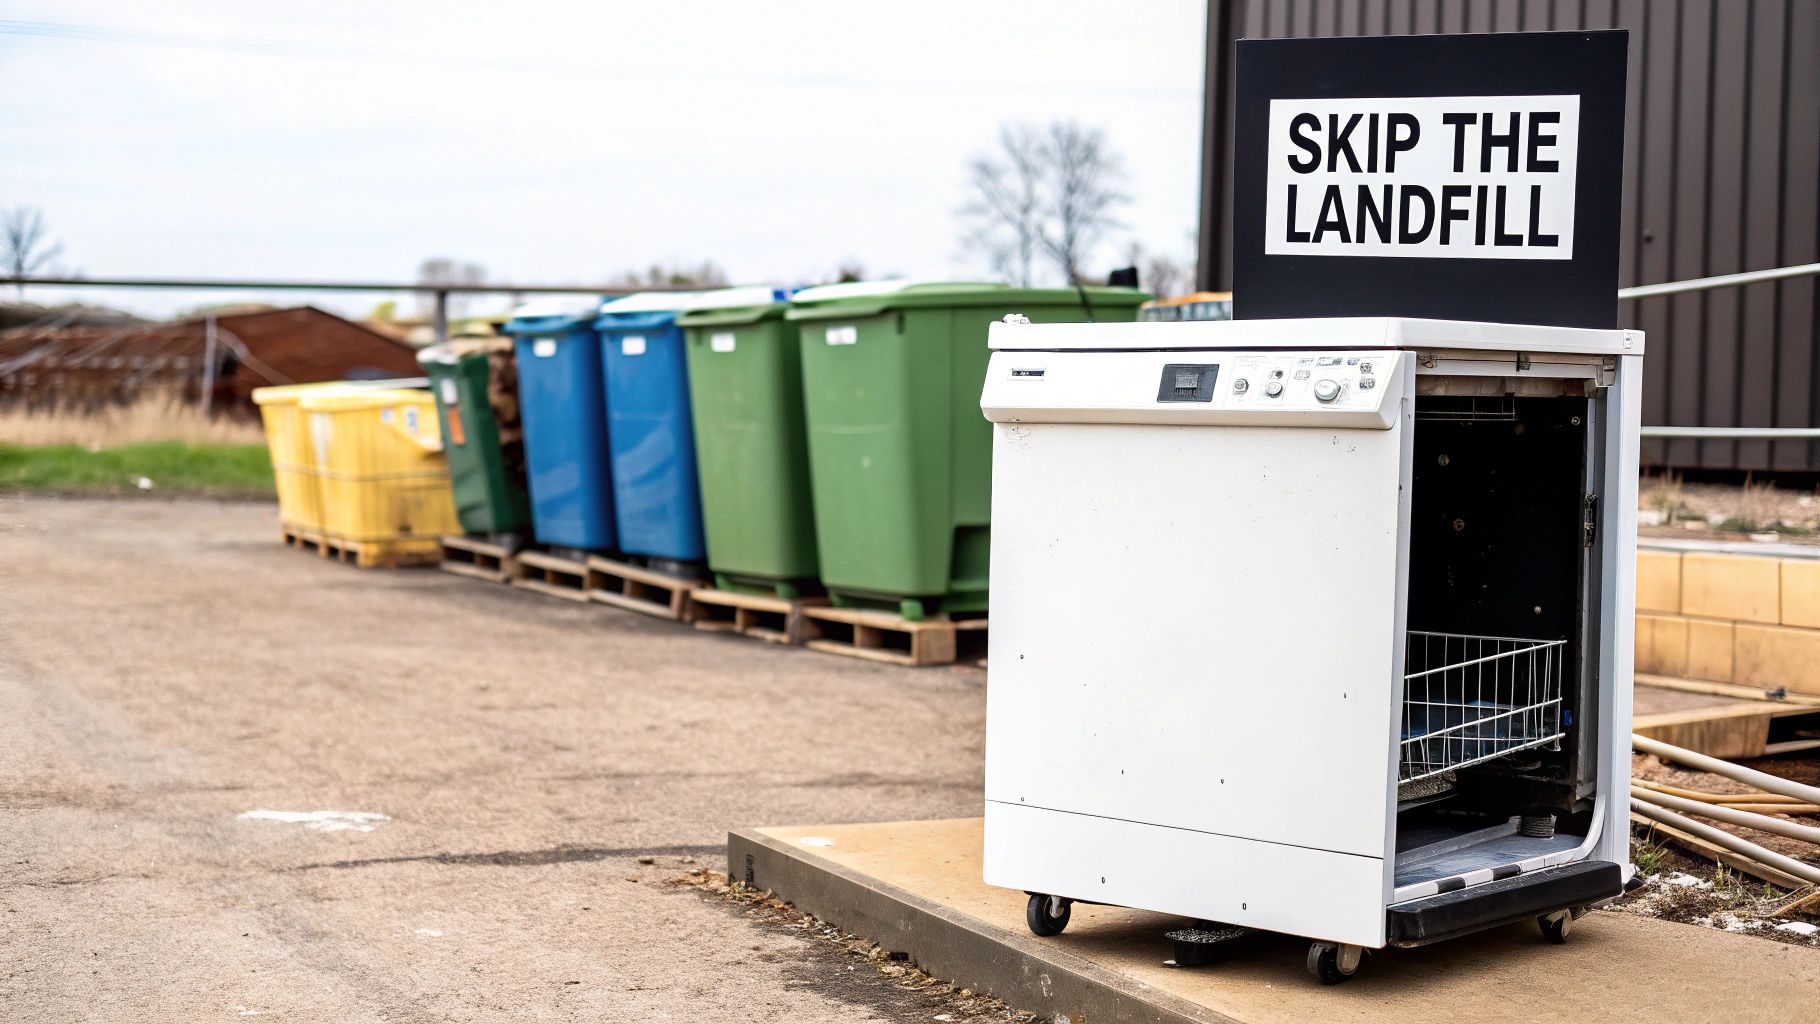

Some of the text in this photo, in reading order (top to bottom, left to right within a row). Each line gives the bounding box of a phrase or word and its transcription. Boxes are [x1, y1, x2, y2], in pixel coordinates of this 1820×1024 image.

[1287, 111, 1561, 174] SKIP THE
[1286, 184, 1559, 247] LANDFILL
